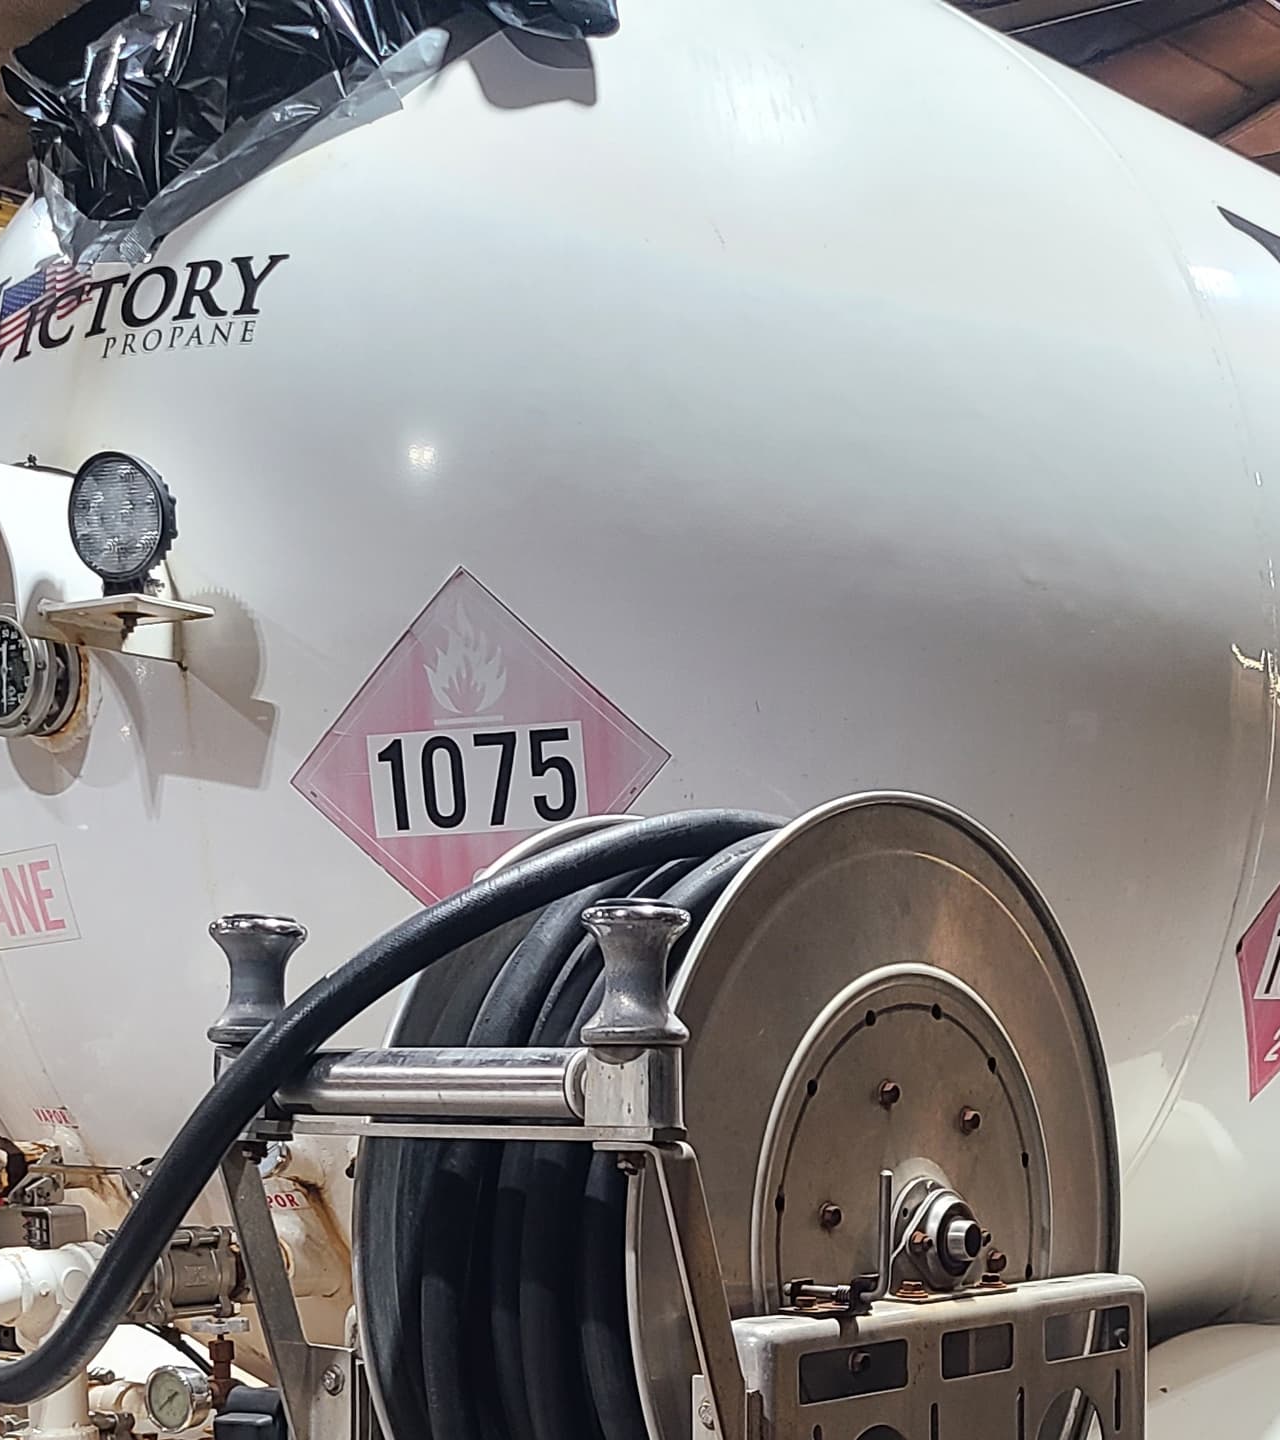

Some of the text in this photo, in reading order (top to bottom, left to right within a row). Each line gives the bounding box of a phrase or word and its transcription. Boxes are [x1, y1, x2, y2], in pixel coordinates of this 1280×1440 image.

[102, 320, 257, 359] PROPANE
[378, 728, 577, 831] 1075
[266, 1193, 299, 1209] POR
